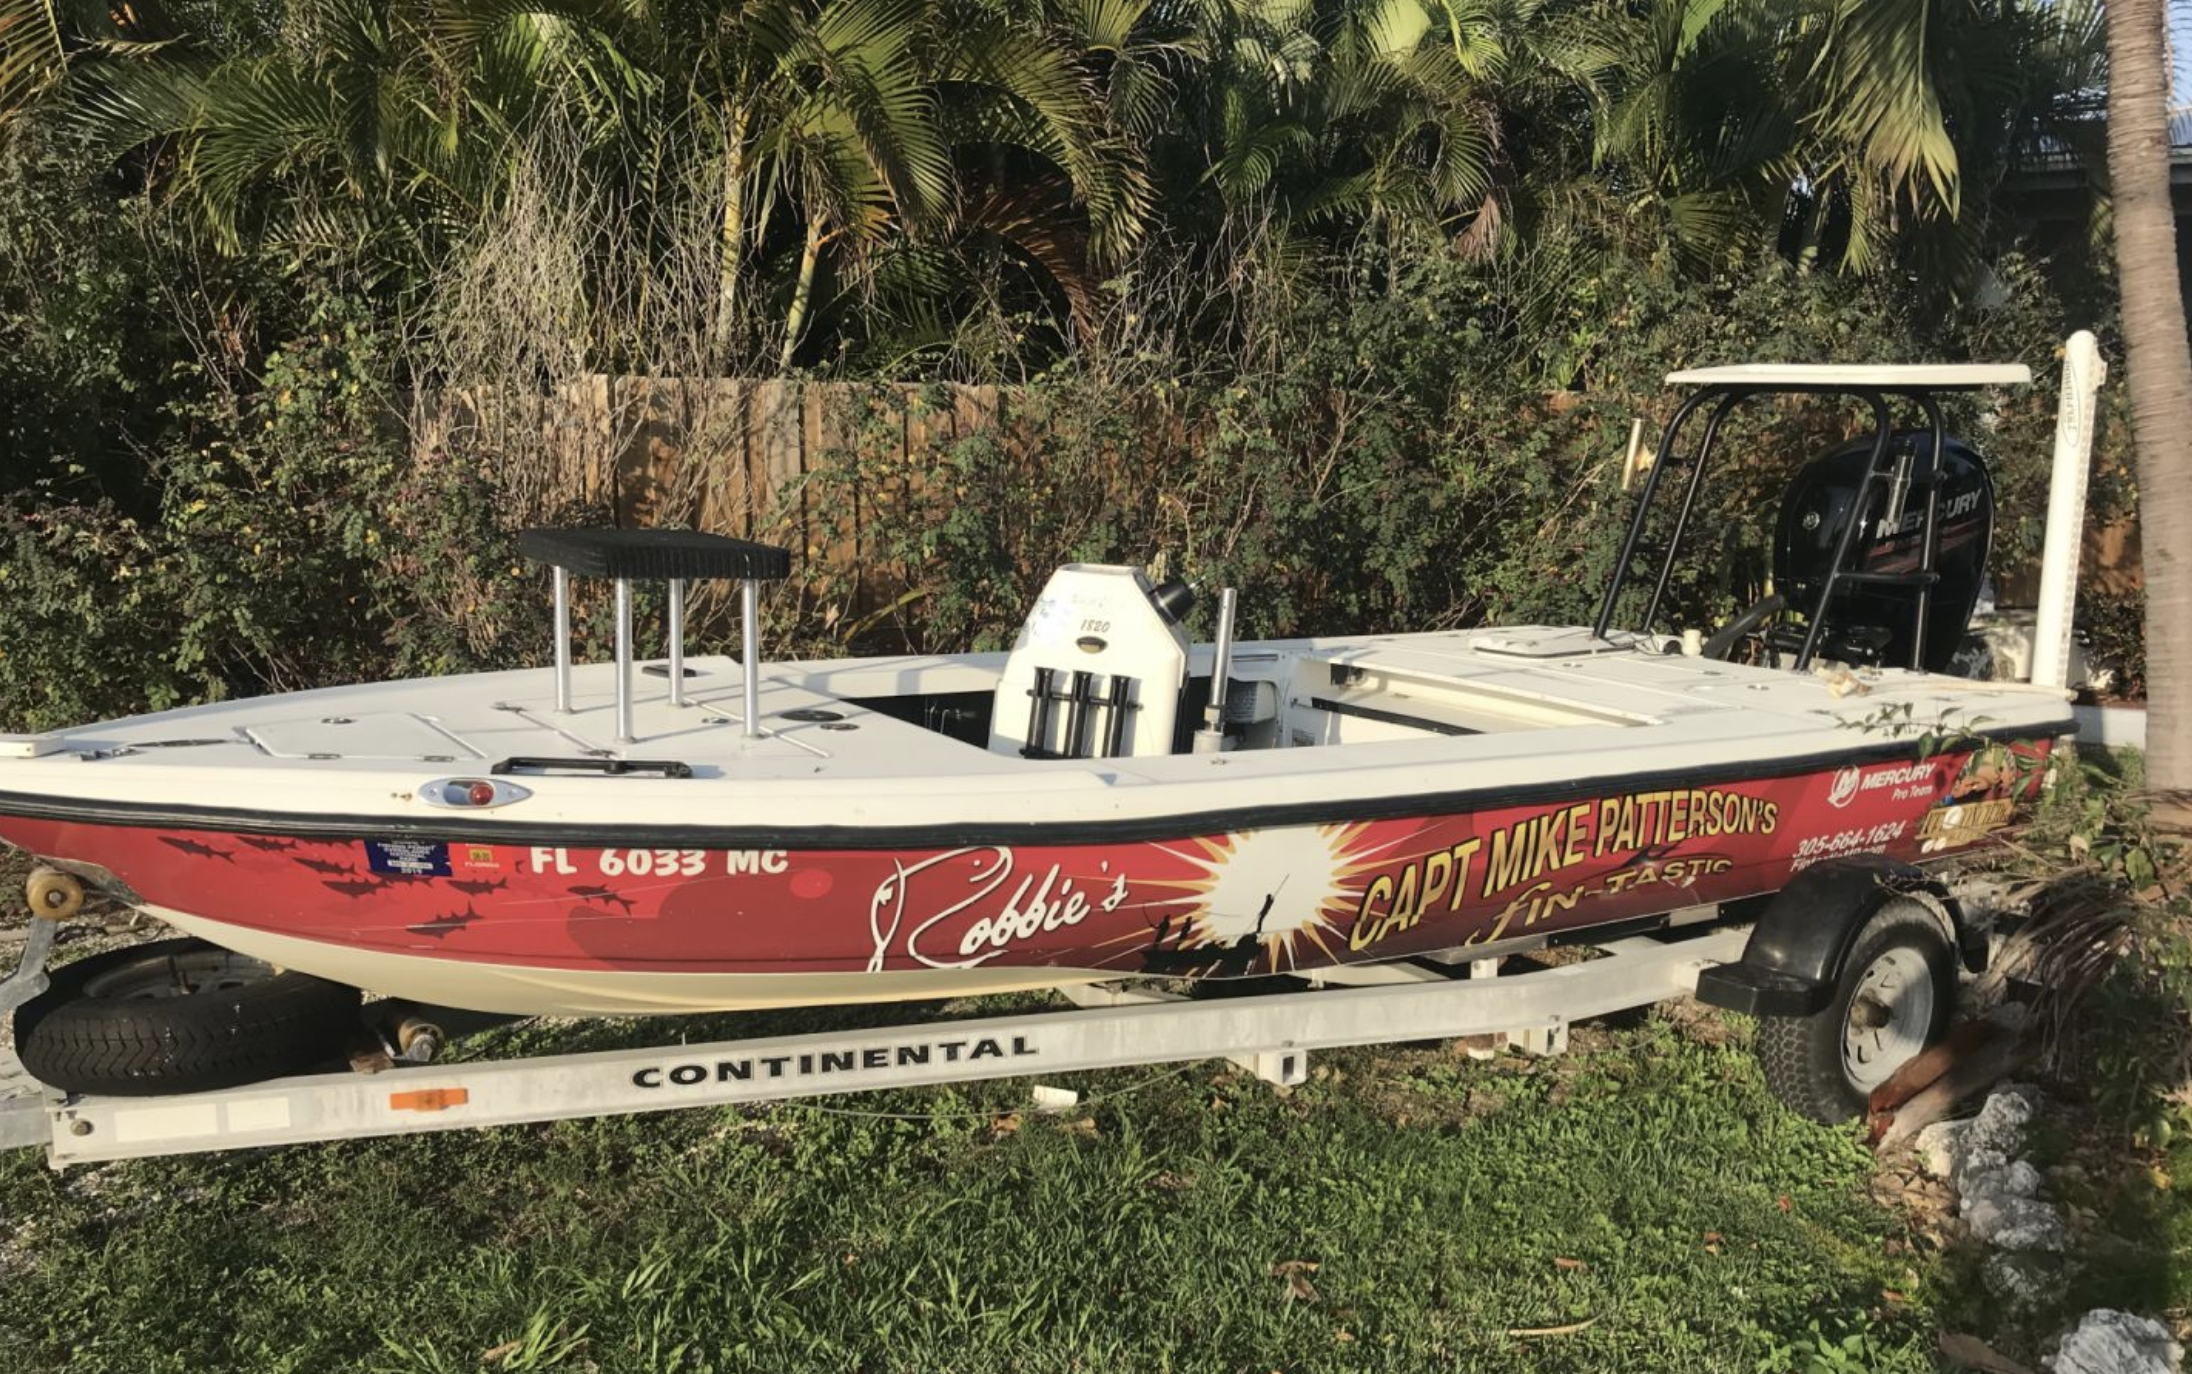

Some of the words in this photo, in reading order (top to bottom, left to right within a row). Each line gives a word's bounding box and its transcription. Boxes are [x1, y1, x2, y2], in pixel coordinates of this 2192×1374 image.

[1080, 619, 1111, 633] 1820
[1860, 762, 1937, 791] MERCURY
[1892, 788, 1908, 801] Pro
[1910, 785, 1933, 798] Team
[1793, 820, 1907, 858] 305-664-1624
[530, 847, 577, 875] FL
[600, 848, 706, 876] 6033
[727, 849, 789, 875] MC
[1349, 836, 1481, 952] CAPT
[1483, 802, 1592, 899] MIKE
[1594, 789, 1779, 859] PATTERSON'S
[867, 845, 1129, 973] Robbie's
[632, 1036, 1039, 1088] CONTINENTAL
